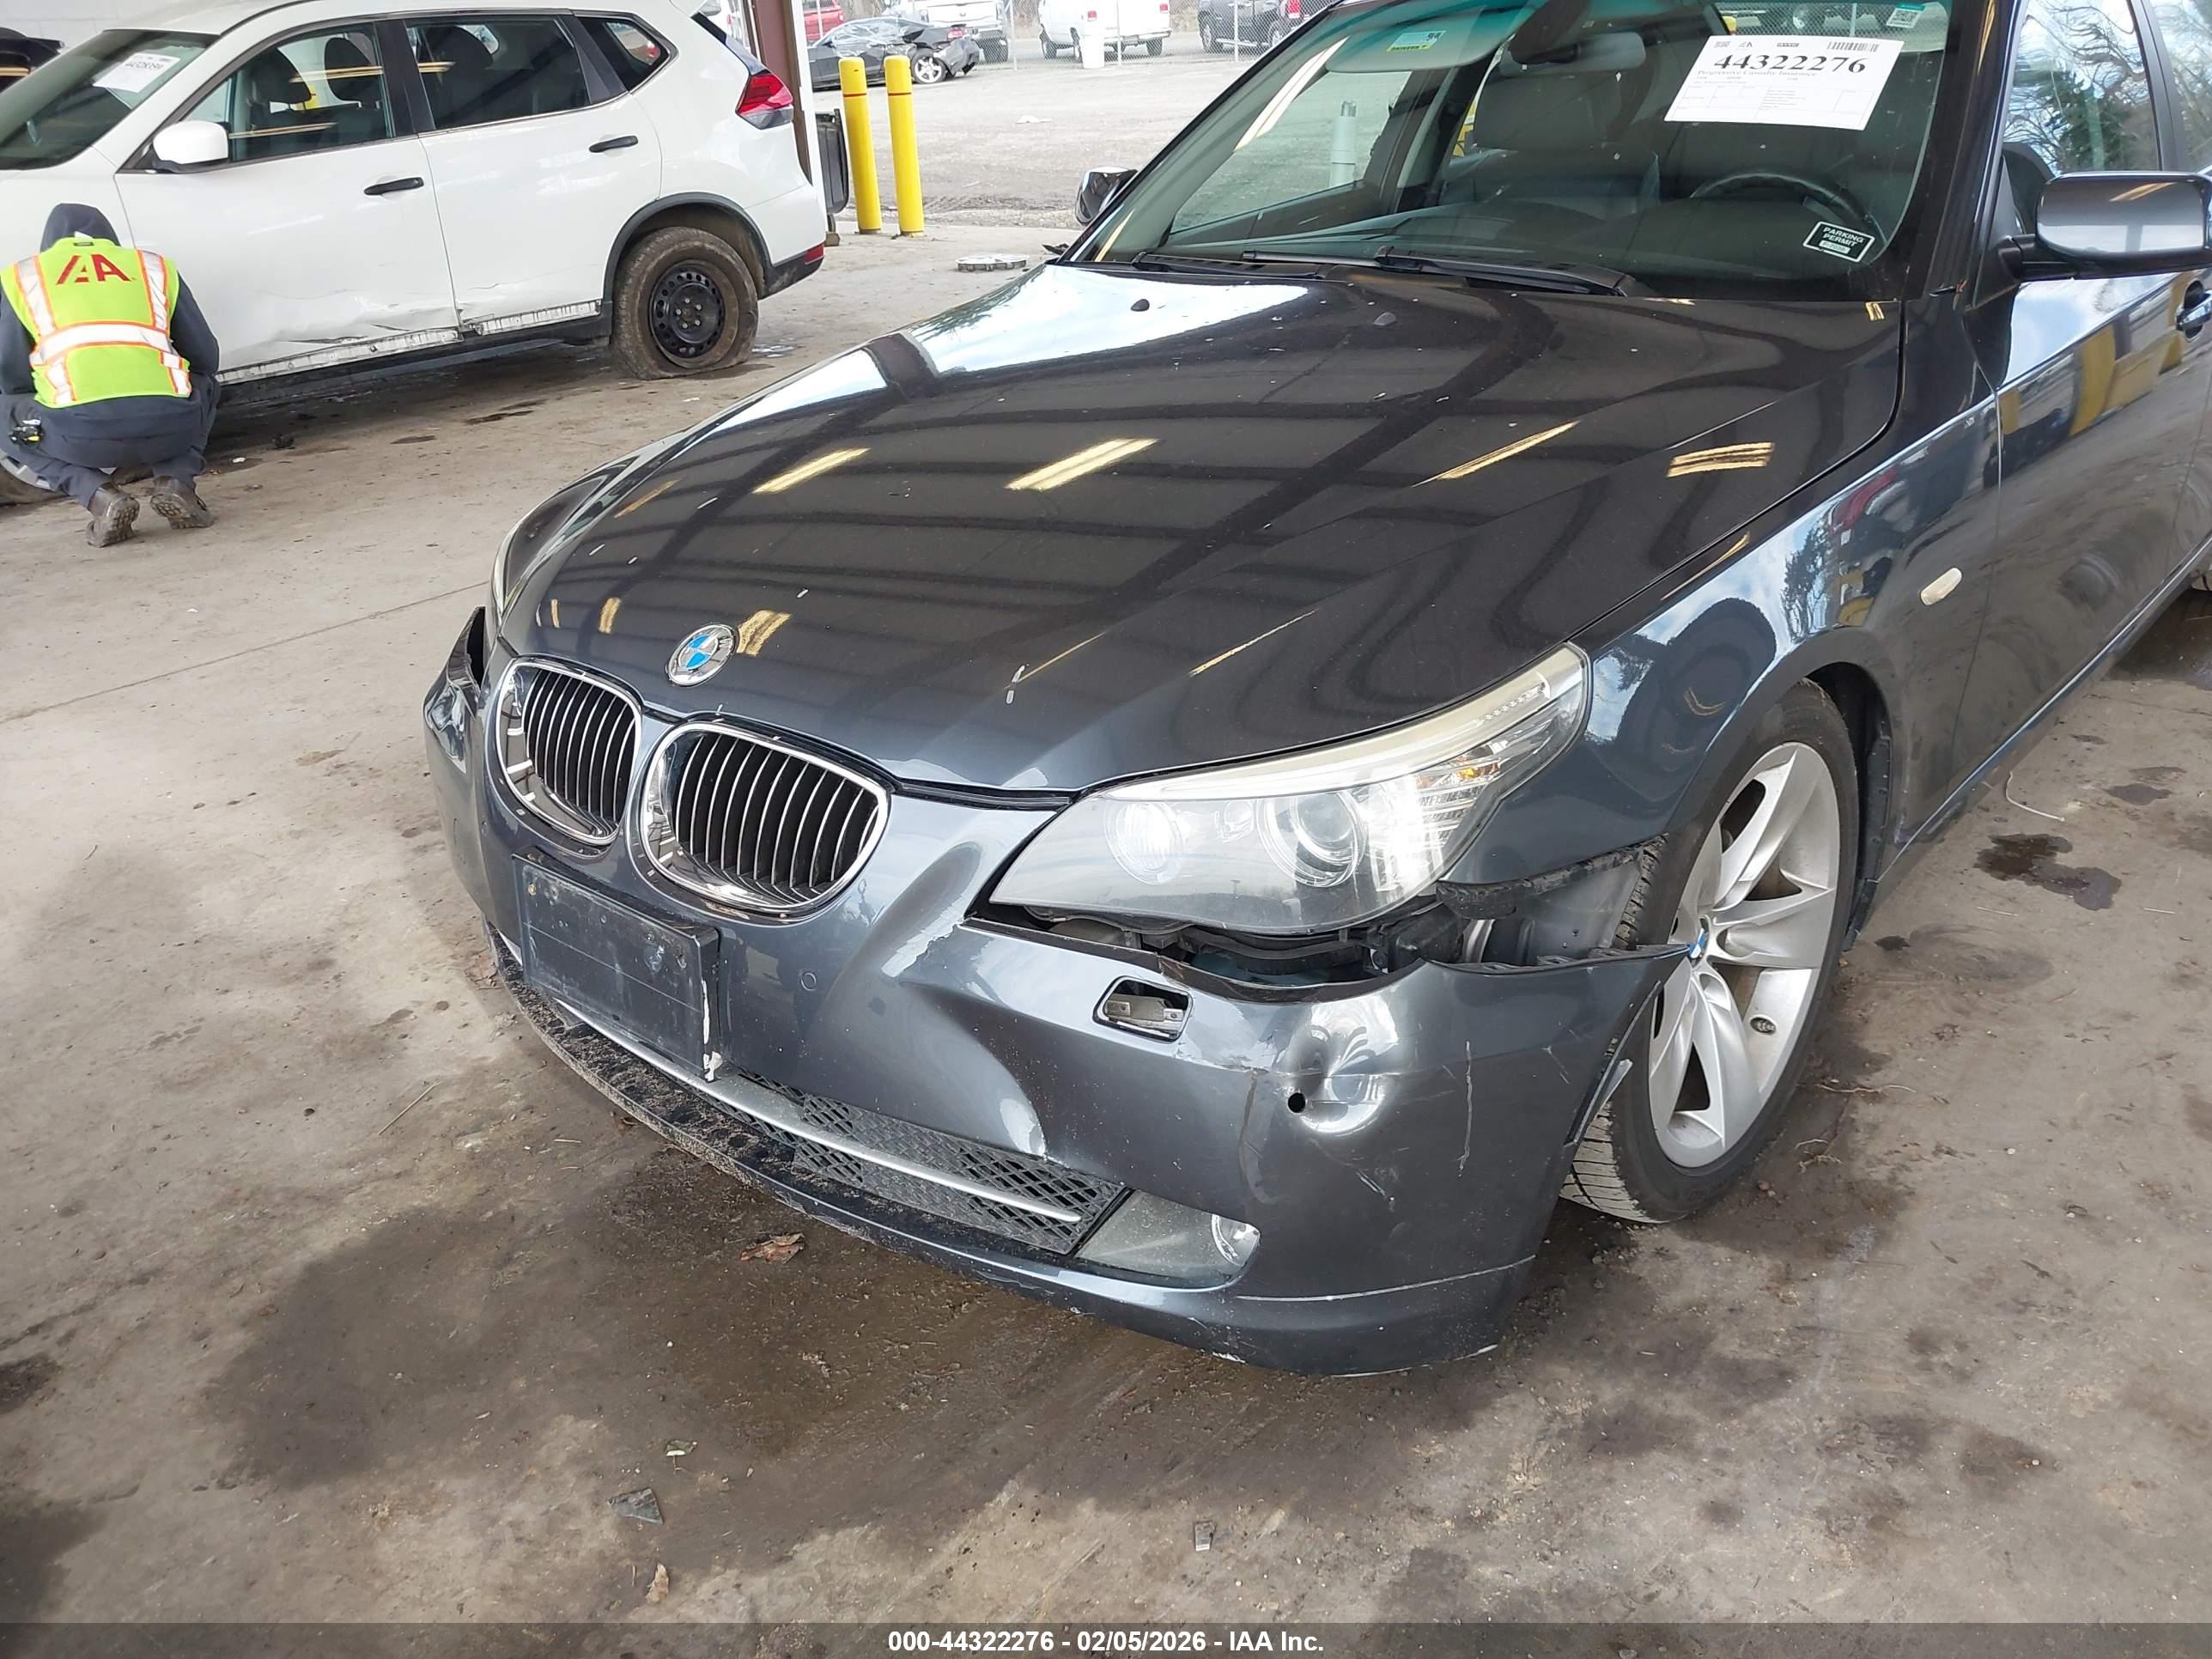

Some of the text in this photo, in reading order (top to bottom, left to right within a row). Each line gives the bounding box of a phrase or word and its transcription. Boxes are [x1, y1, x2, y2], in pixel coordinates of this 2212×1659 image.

[1714, 54, 1869, 74] 44322276
[1823, 227, 1865, 243] PARKING
[1823, 233, 1857, 246] PERMIT
